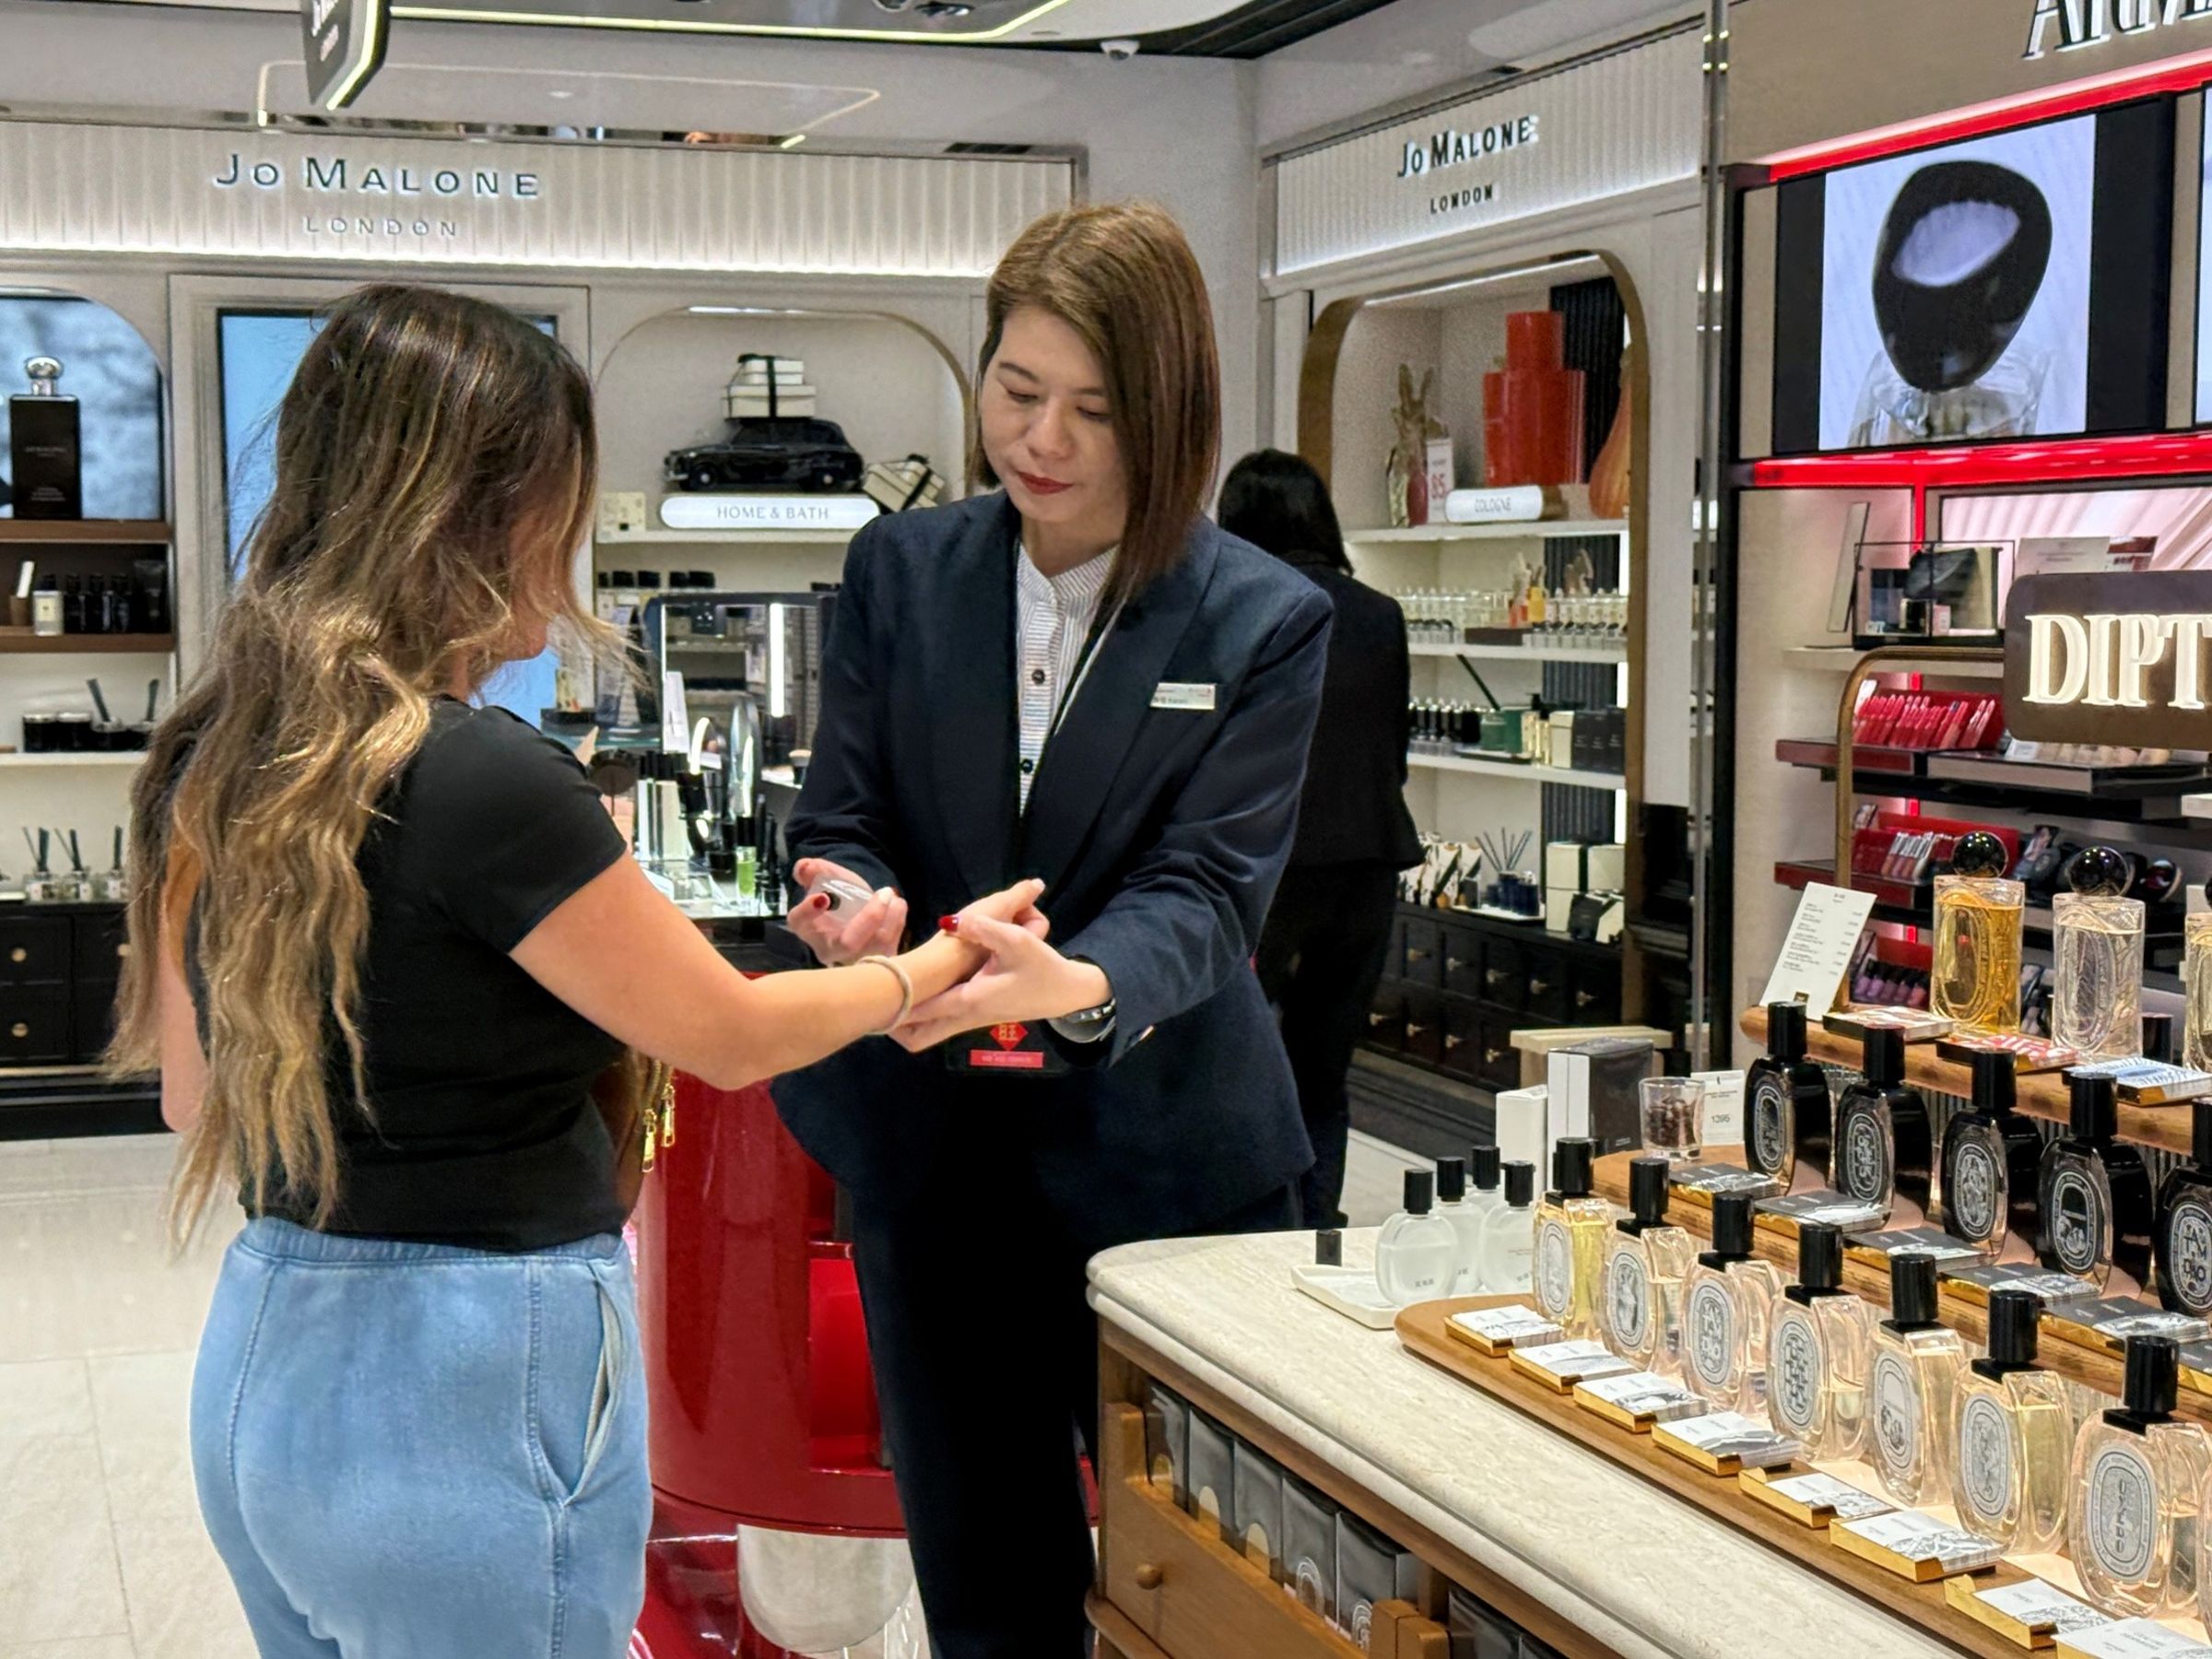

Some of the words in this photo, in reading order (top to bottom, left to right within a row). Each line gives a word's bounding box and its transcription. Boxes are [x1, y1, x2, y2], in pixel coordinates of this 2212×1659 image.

[1430, 183, 1493, 214] LONDON
[305, 217, 456, 237] LONDON
[717, 506, 766, 519] HOME
[770, 506, 780, 518] &
[786, 507, 829, 519] BATH
[1475, 497, 1512, 512] COLOGNE
